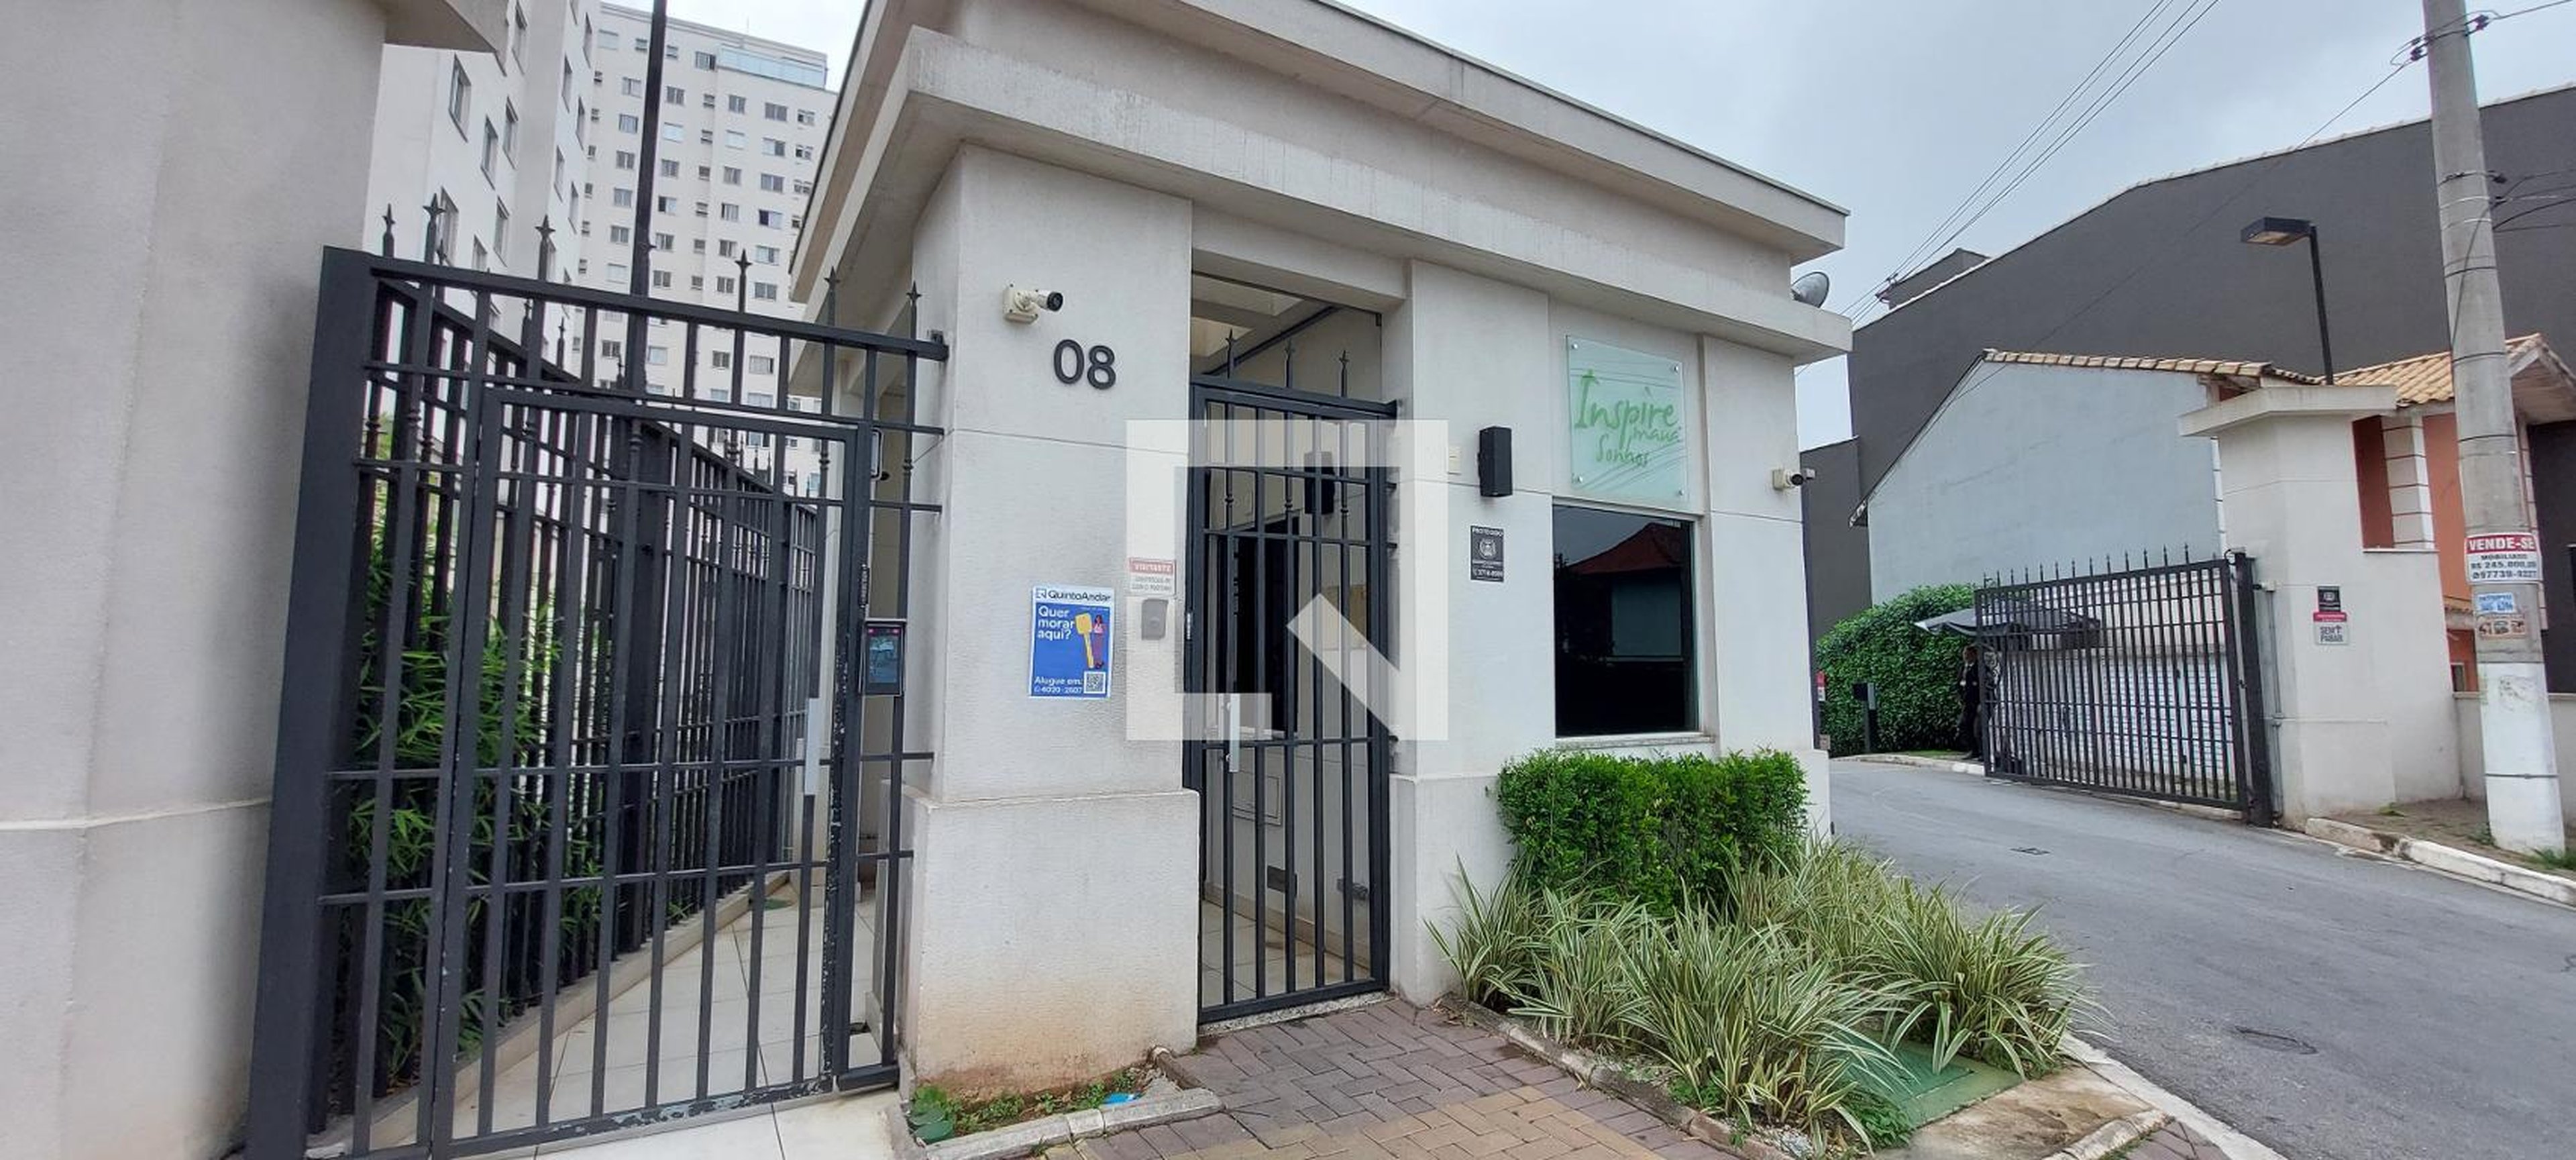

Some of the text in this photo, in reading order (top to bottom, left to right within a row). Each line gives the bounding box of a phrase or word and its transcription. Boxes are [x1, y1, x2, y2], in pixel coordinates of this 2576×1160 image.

[1053, 339, 1116, 390] 08
[1574, 369, 1678, 450] Inspire
[2469, 537, 2536, 551] VENDE-SE
[1048, 590, 1111, 602] QuintoAndar
[1038, 605, 1070, 618] Quer
[1038, 619, 1075, 629] morar
[1037, 629, 1072, 641] aqui?
